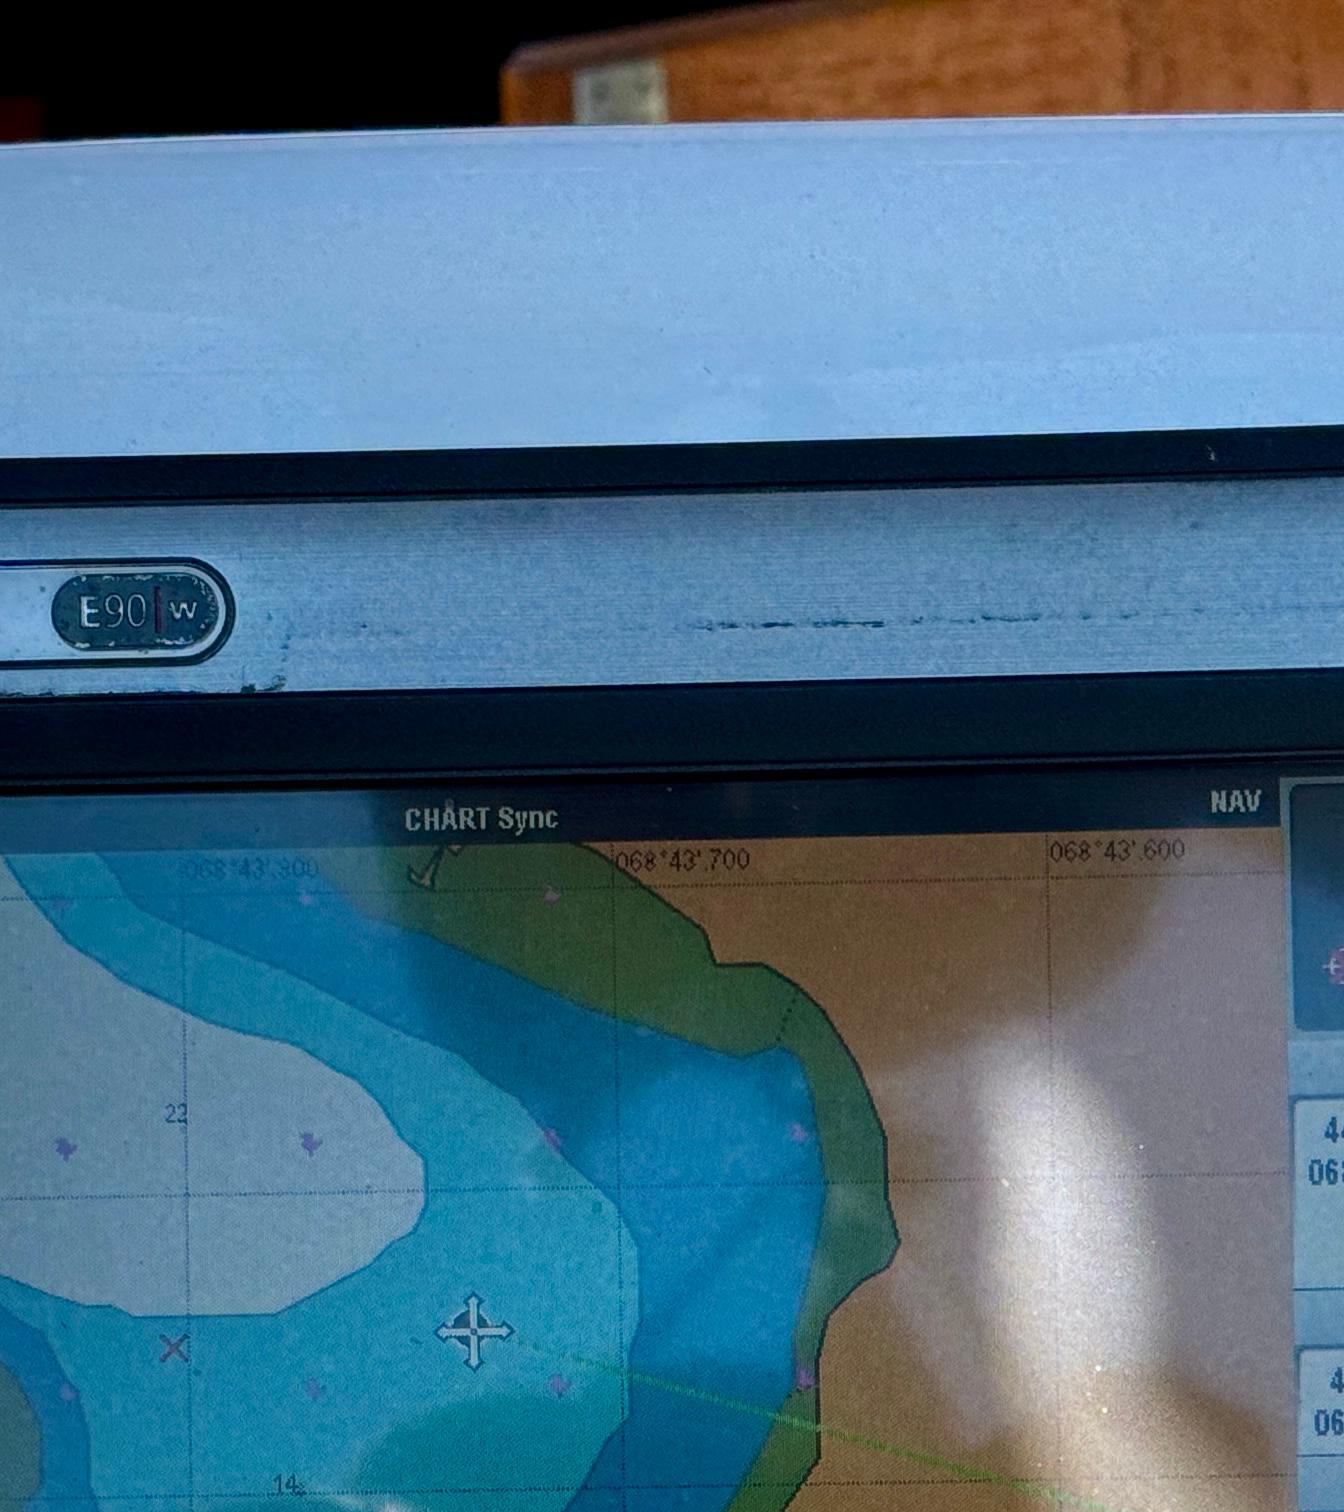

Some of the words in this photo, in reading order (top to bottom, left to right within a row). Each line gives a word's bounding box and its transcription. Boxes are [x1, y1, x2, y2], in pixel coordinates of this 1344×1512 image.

[79, 593, 147, 629] E90
[1210, 789, 1262, 814] NAV
[404, 806, 490, 831] CHART
[497, 805, 559, 835] Sync
[613, 847, 751, 872] 068°43'.700
[1049, 838, 1186, 863] 068°43'.600
